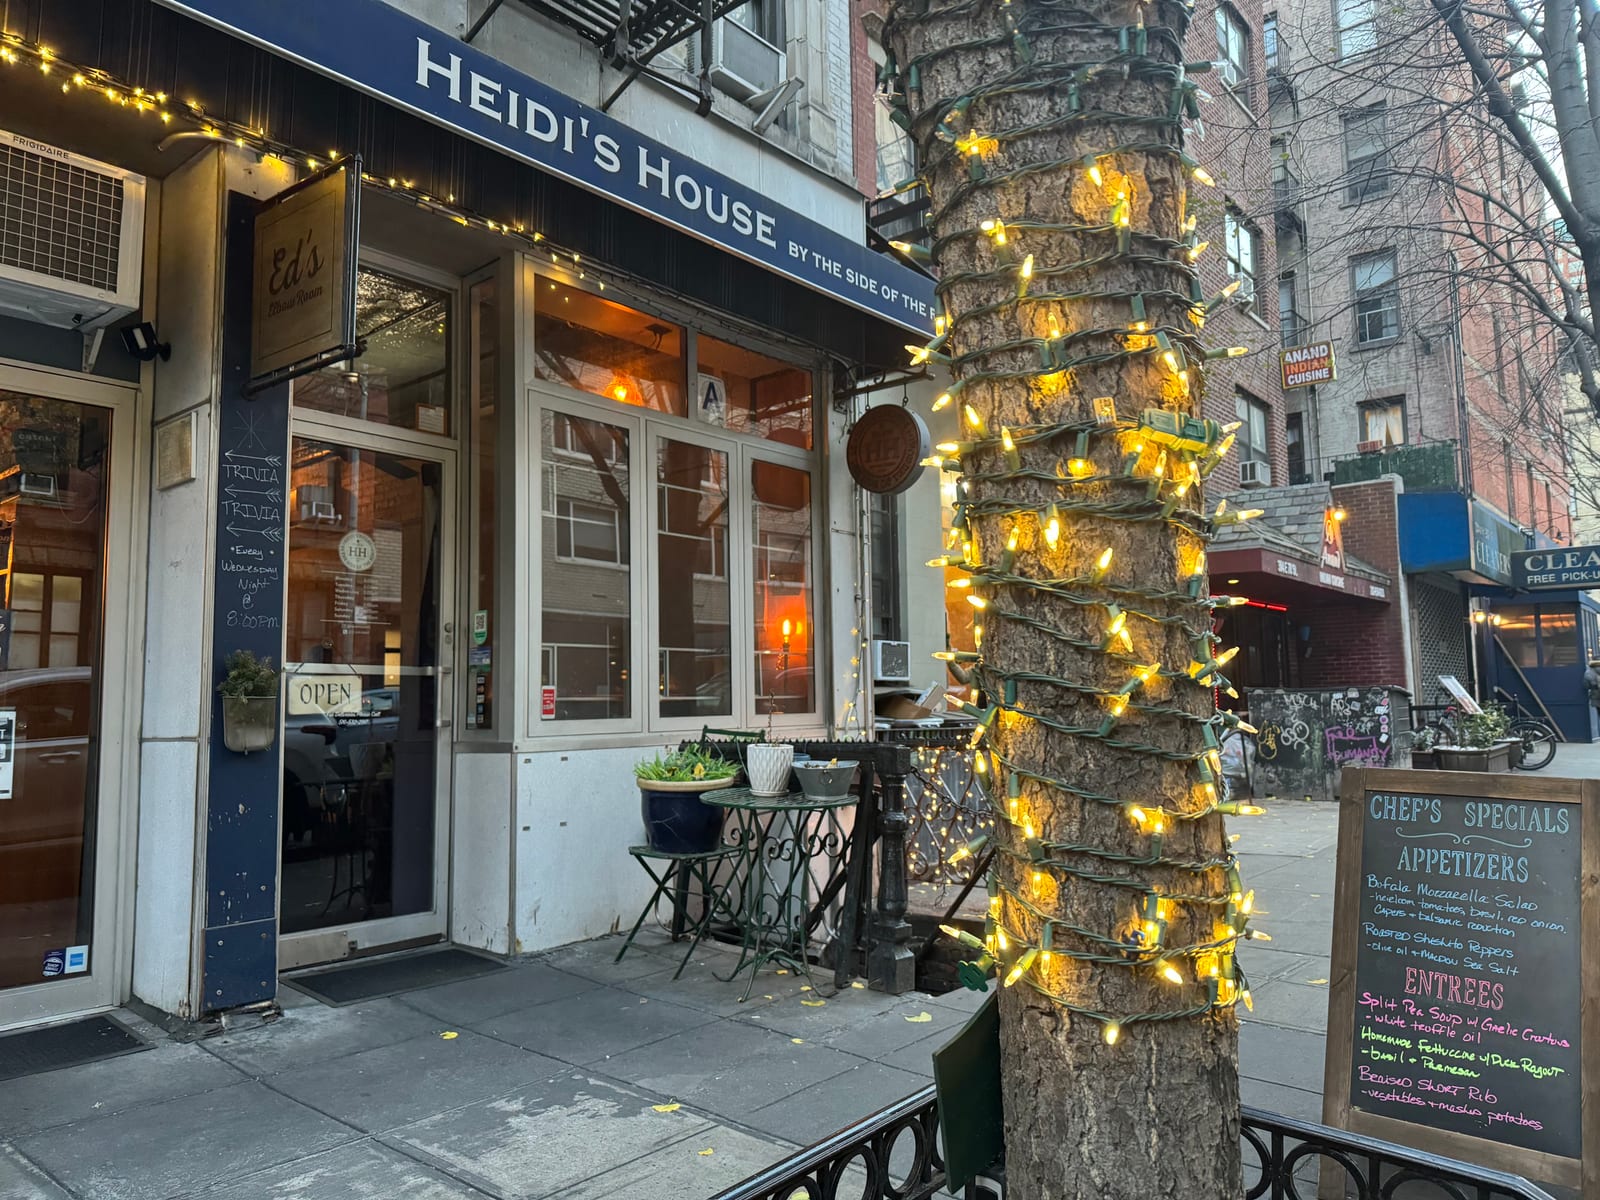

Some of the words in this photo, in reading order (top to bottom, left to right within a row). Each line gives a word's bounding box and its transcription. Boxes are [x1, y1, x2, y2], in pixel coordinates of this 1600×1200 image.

[12, 135, 70, 159] FRIGIDAIRE
[415, 36, 622, 173] HEIDI'S
[637, 145, 777, 250] HOUSE
[788, 239, 809, 262] BY
[812, 252, 842, 279] THE
[846, 268, 879, 295] SIDE
[881, 285, 899, 303] OF
[902, 293, 927, 317] THE
[268, 228, 325, 296] Ed's
[1285, 344, 1329, 363] ANAND
[1286, 356, 1329, 375] INDIAN
[1287, 367, 1330, 386] CUISINE
[702, 381, 721, 410] A
[222, 463, 280, 484] TRIVIA
[221, 500, 281, 522] TRIVIA
[348, 546, 367, 558] HH
[238, 578, 271, 595] Night
[1527, 573, 1556, 585] FREE
[300, 682, 352, 706] OPEN
[1369, 794, 1442, 824] CHEF'S
[1464, 801, 1569, 834] SPECIALS
[1396, 845, 1529, 884] APPETIZERS
[1467, 940, 1515, 959] Peppers
[1488, 962, 1519, 976] Salt
[1404, 966, 1504, 1011] ENTREES
[1358, 992, 1398, 1012] Split
[1402, 999, 1425, 1017] Pea
[1428, 1006, 1463, 1028] Soup
[1462, 1031, 1481, 1044] oil
[1468, 1085, 1498, 1104] Rib
